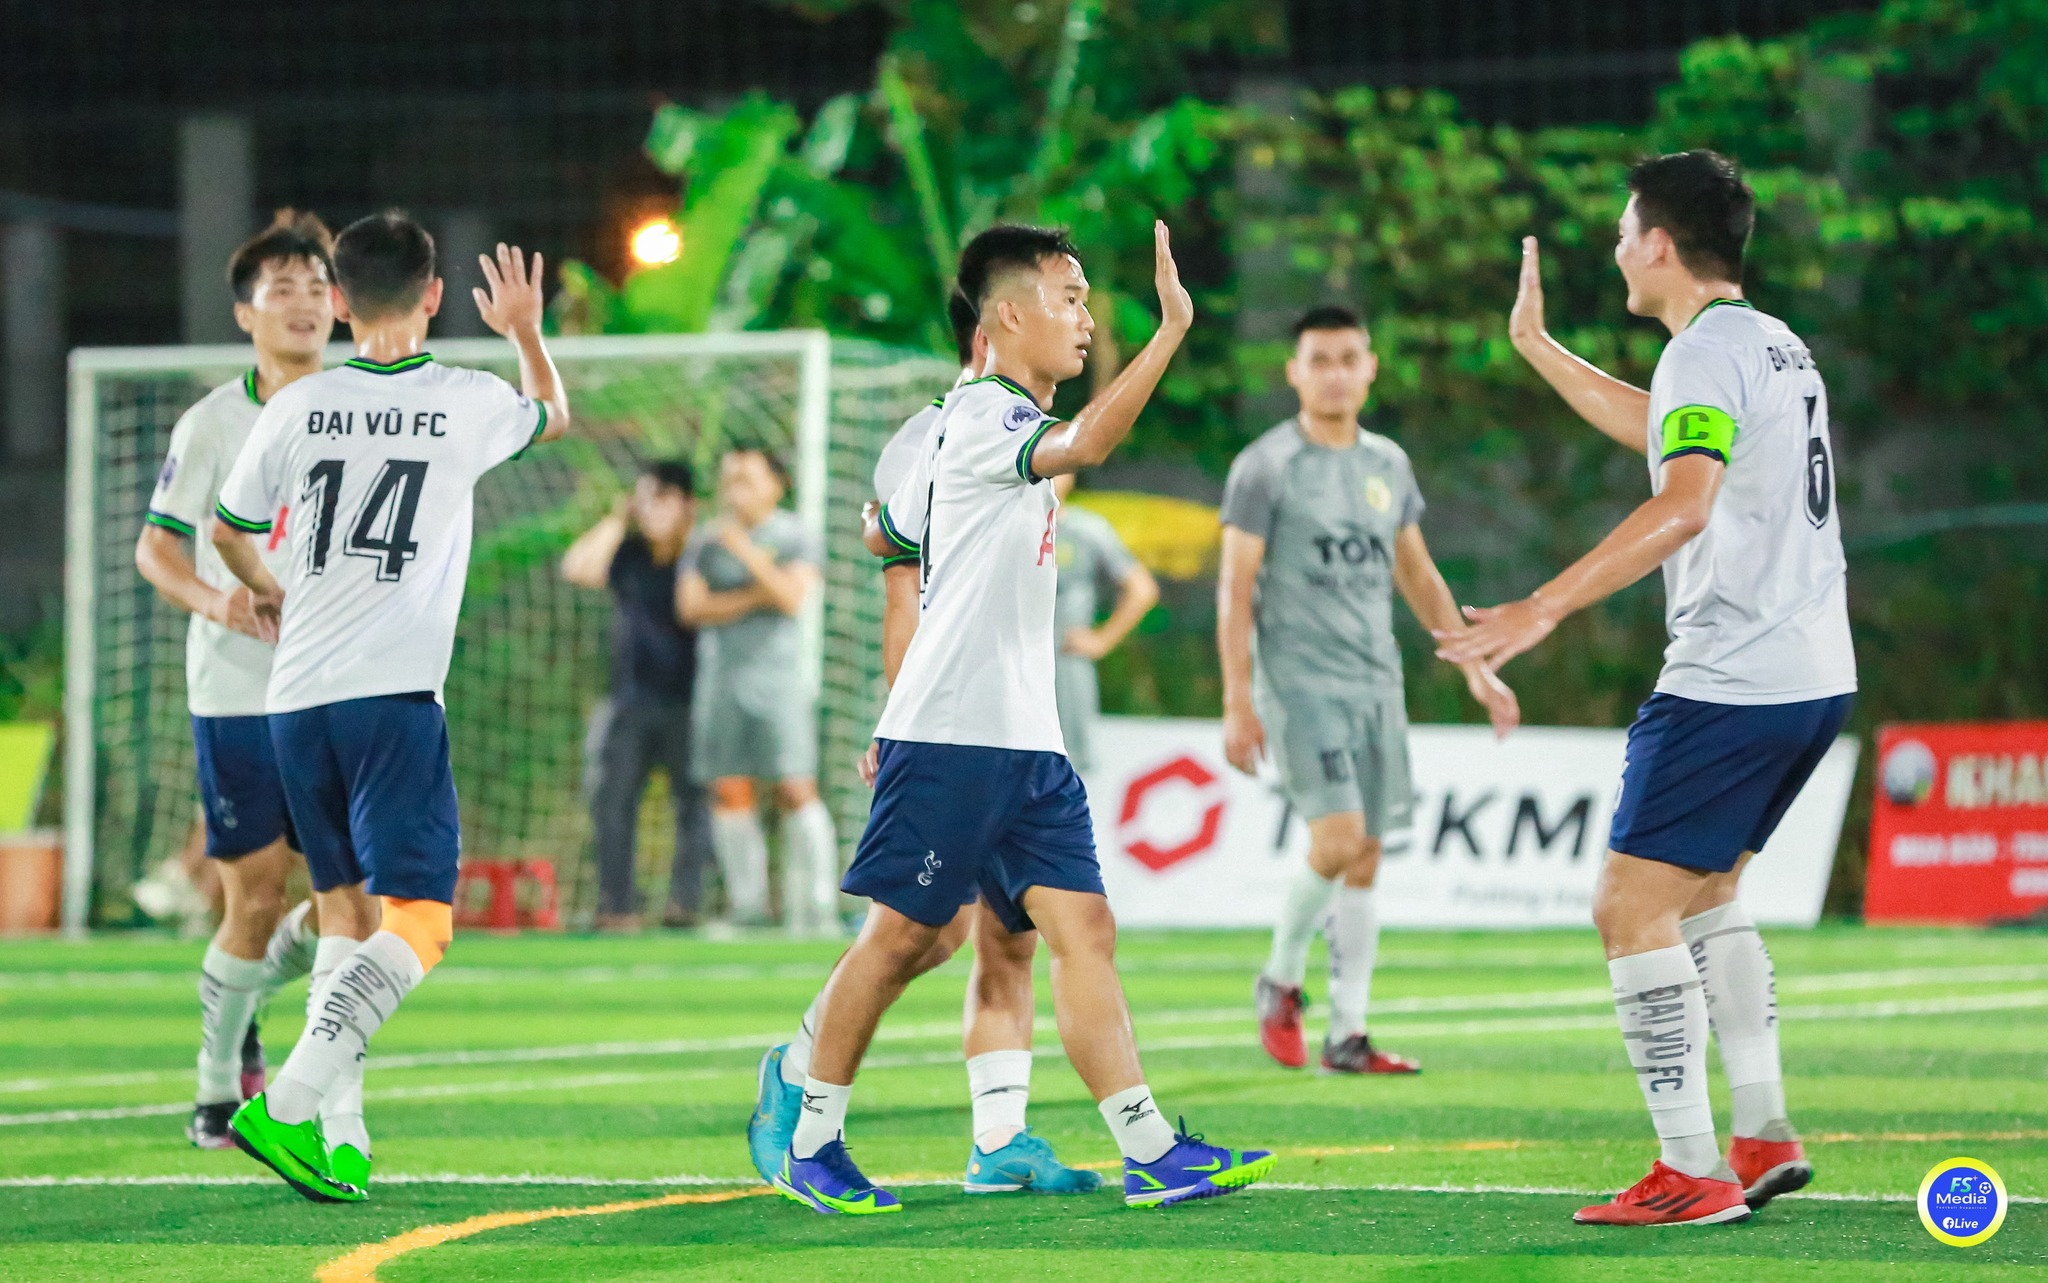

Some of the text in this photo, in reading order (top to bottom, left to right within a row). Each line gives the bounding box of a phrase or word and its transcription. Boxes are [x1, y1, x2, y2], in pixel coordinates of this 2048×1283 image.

[307, 407, 447, 441] ĐẠI VŨ FC
[1678, 412, 1711, 441] C
[301, 459, 430, 582] 14
[311, 1017, 343, 1042] FC
[1641, 1027, 1692, 1060] VŨ
[1648, 1065, 1684, 1093] FC
